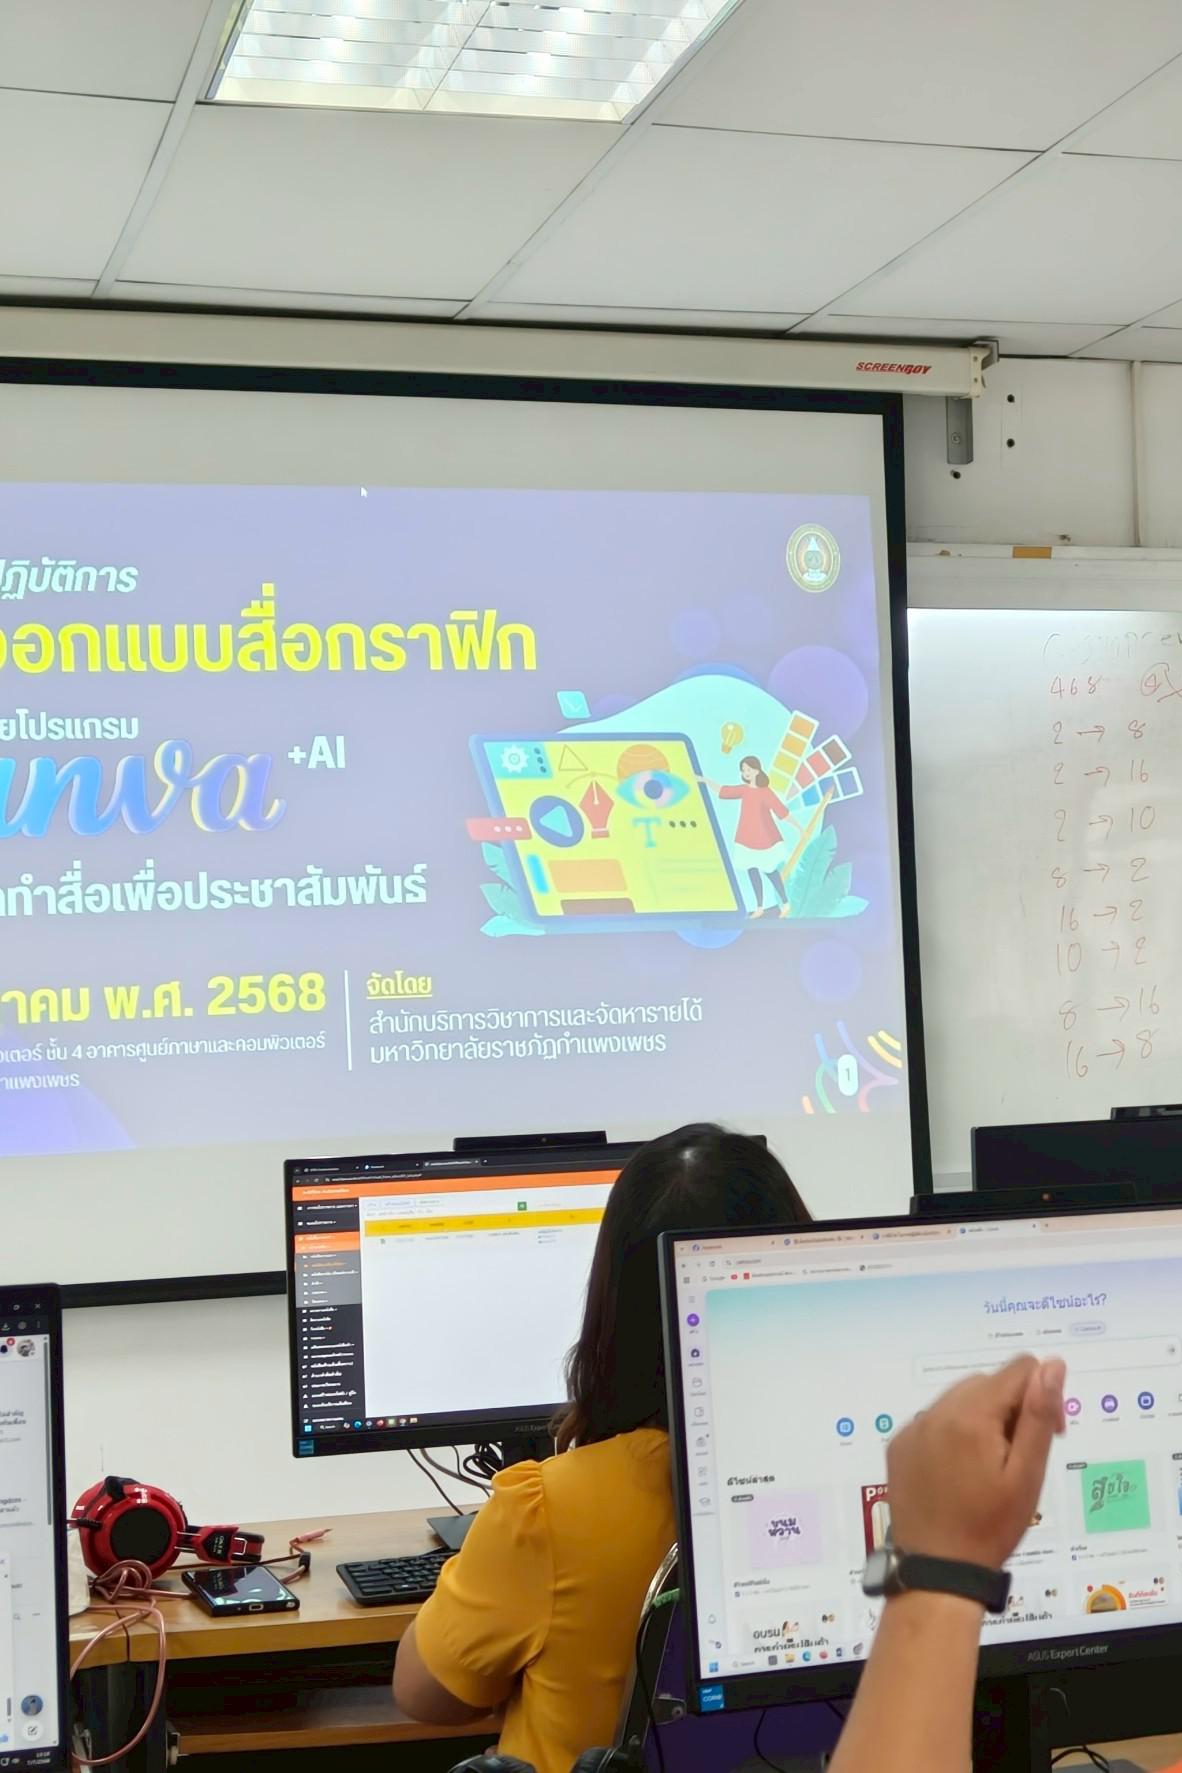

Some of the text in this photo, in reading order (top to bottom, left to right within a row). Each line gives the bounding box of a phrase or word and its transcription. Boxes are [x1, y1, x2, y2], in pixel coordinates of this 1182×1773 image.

[0, 583, 537, 673] อกแบบสื่อกราฟิก
[287, 735, 346, 770] +AI
[103, 980, 194, 1021] พ.ศ.
[207, 971, 327, 1016] 2568
[366, 970, 432, 998] จัดโดย
[369, 997, 703, 1034] สำนักบริการวิชาการและจัดหารายได้
[71, 1044, 83, 1060] 4
[86, 1030, 327, 1063] อาคารศูนย์ภาษาและคอมพิวเตอร์
[370, 1032, 667, 1064] มหาวิทยาลัยราชภัฏกำแพงเพชร
